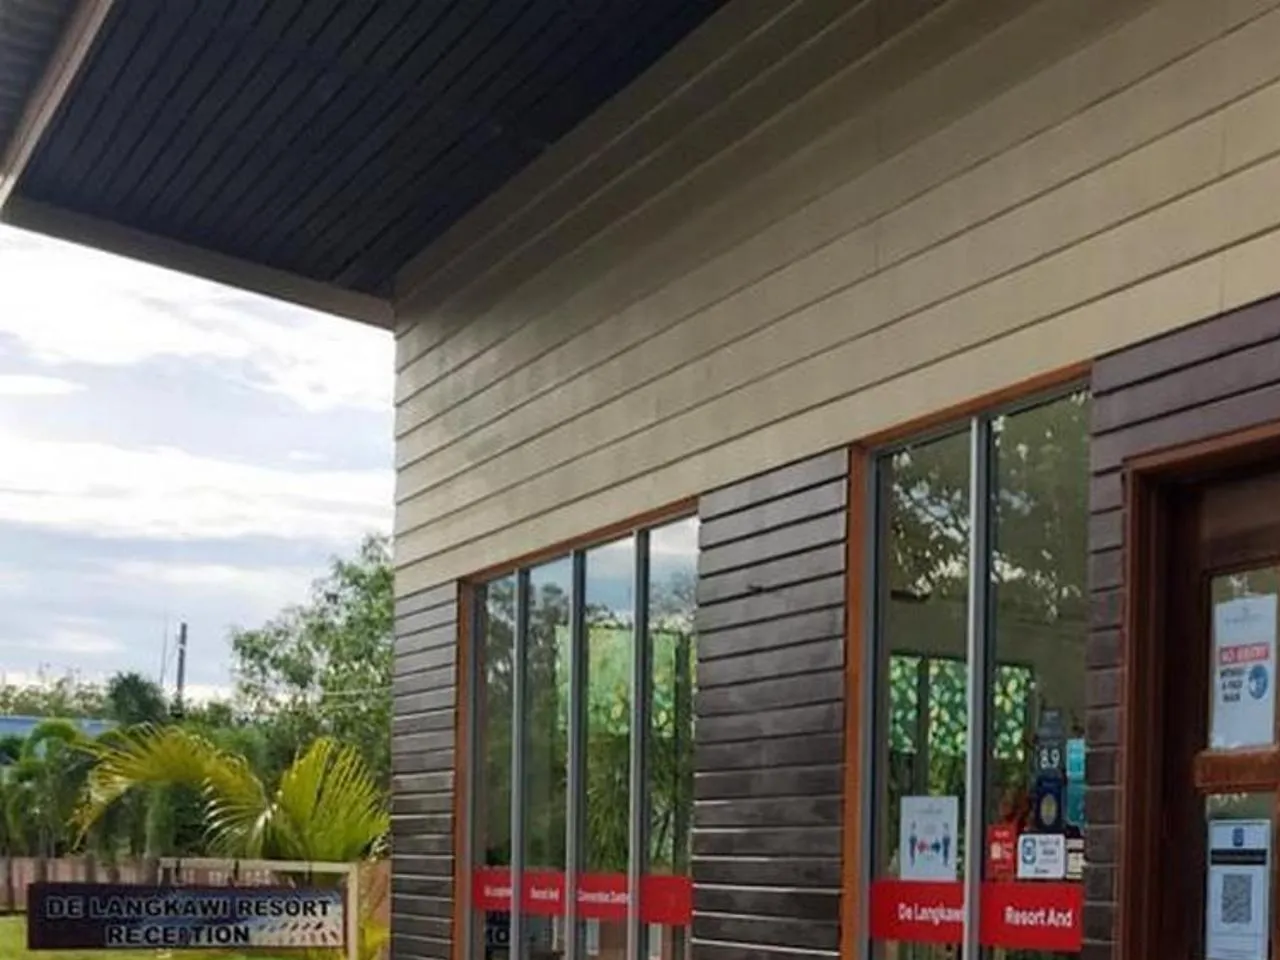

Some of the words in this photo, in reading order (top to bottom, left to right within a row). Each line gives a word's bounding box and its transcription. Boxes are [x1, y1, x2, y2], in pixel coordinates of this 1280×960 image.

[46, 896, 83, 919] DE
[90, 898, 228, 919] LANGKAWI
[237, 899, 331, 918] RESORT
[898, 903, 912, 920] De
[914, 904, 966, 925] Langkaw
[1005, 907, 1044, 926] Resort
[1046, 910, 1072, 927] And
